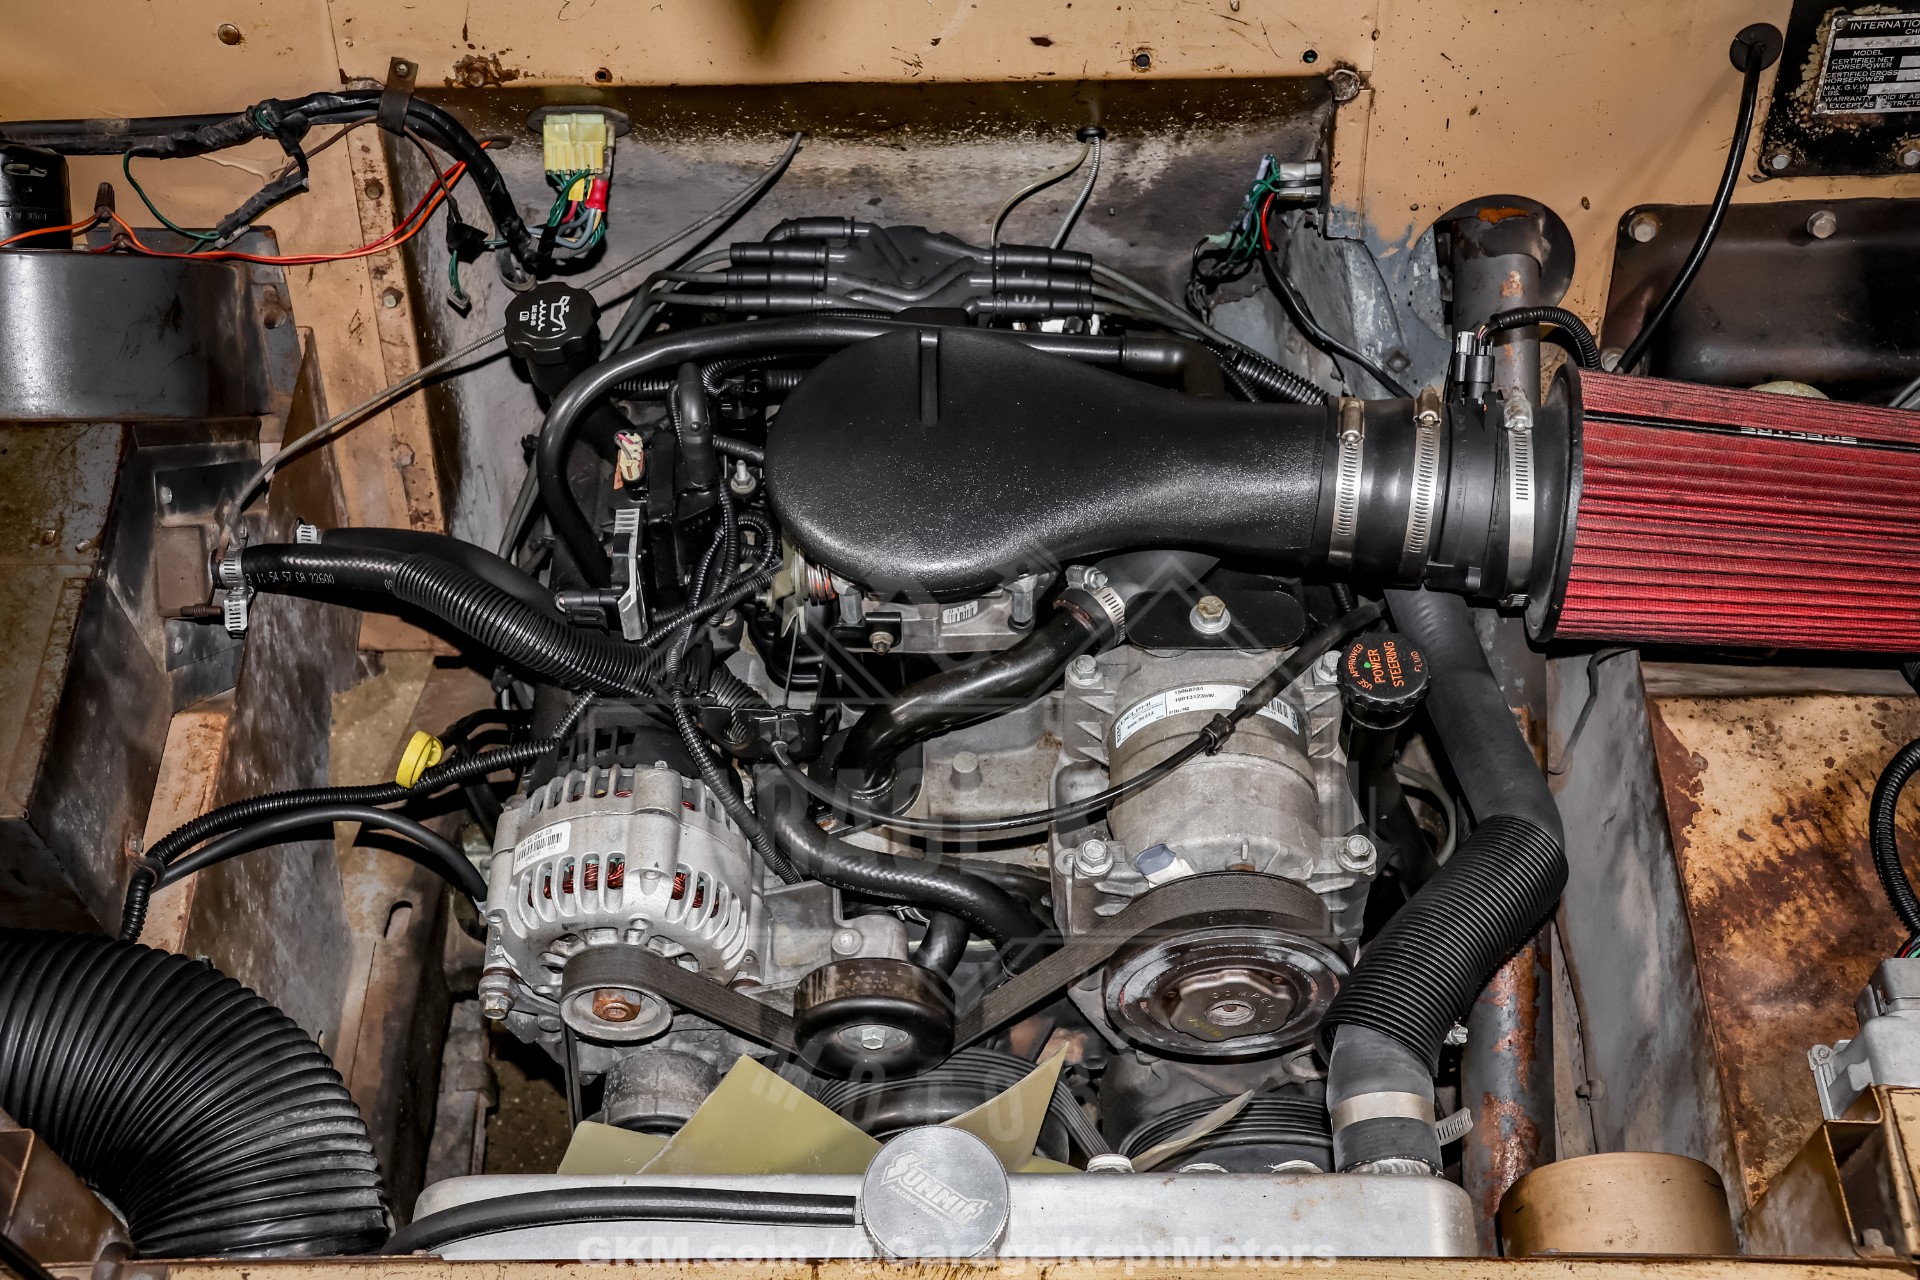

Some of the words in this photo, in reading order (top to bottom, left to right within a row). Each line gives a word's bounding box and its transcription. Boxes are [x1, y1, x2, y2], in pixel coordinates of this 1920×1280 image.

[1348, 643, 1363, 678] APPROVED
[1367, 648, 1386, 683] POWER
[1384, 641, 1404, 688] STEERING
[1410, 650, 1422, 672] FLUID
[1357, 678, 1373, 690] USE
[1120, 702, 1151, 726] DELPHI
[880, 1150, 990, 1224] SUMMIT
